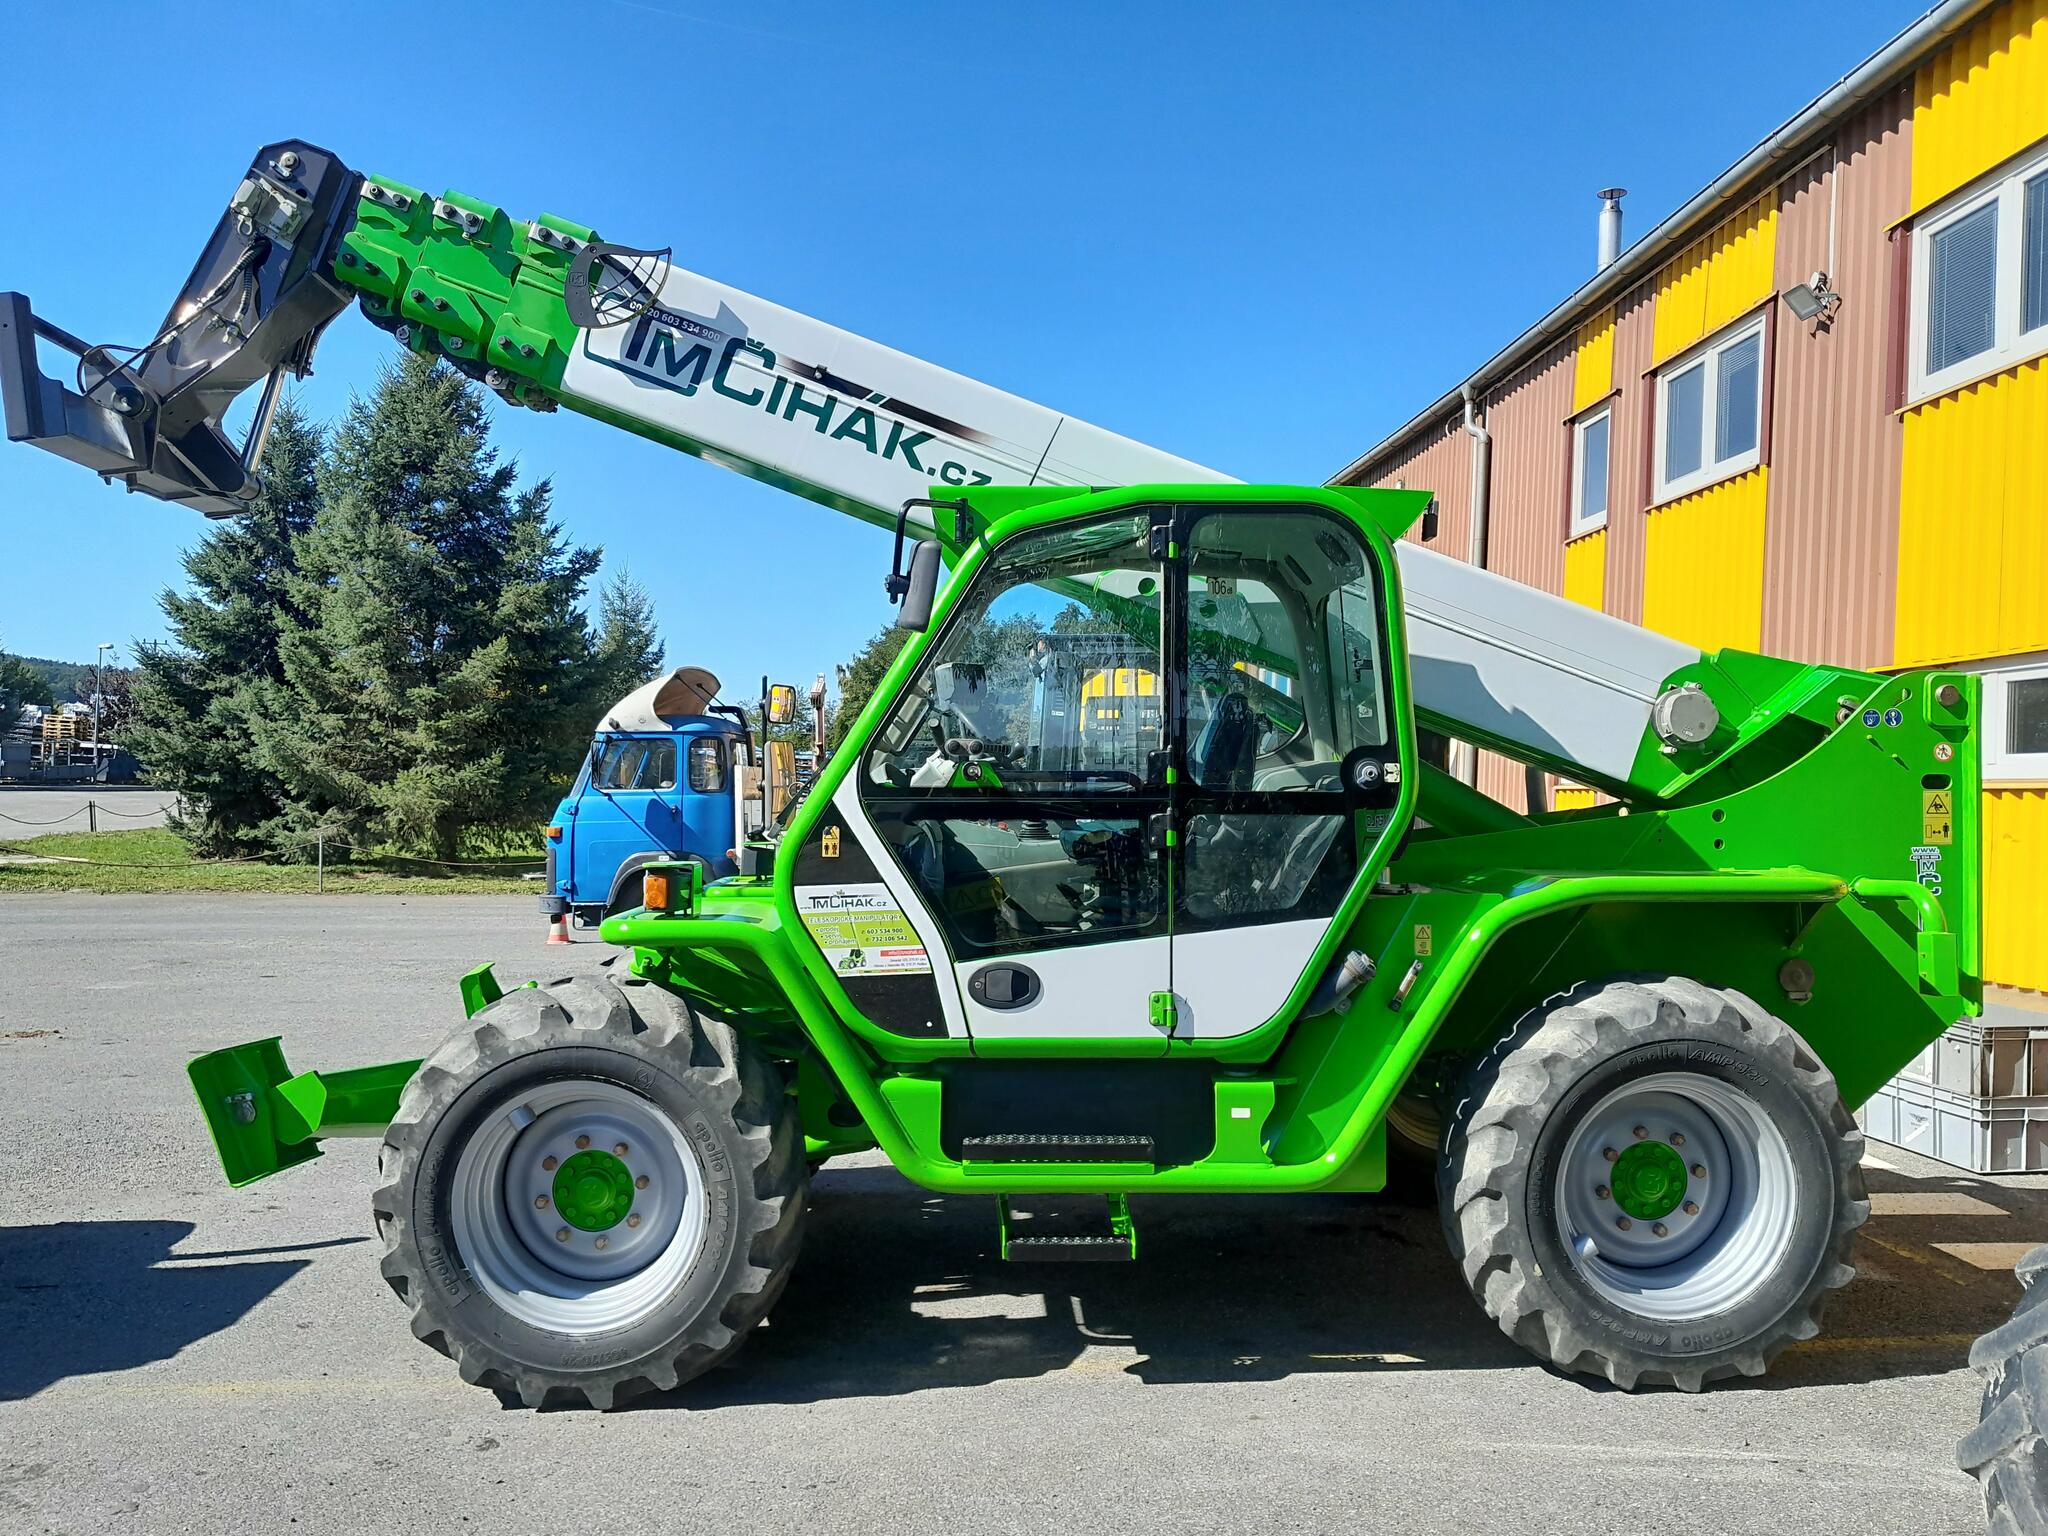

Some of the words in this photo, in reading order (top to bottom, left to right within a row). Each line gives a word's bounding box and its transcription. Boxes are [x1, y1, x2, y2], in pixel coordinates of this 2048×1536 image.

[629, 301, 659, 320] 0020
[661, 313, 680, 327] 603
[681, 321, 700, 335] 534
[702, 328, 721, 342] 900
[1211, 580, 1226, 595] 106
